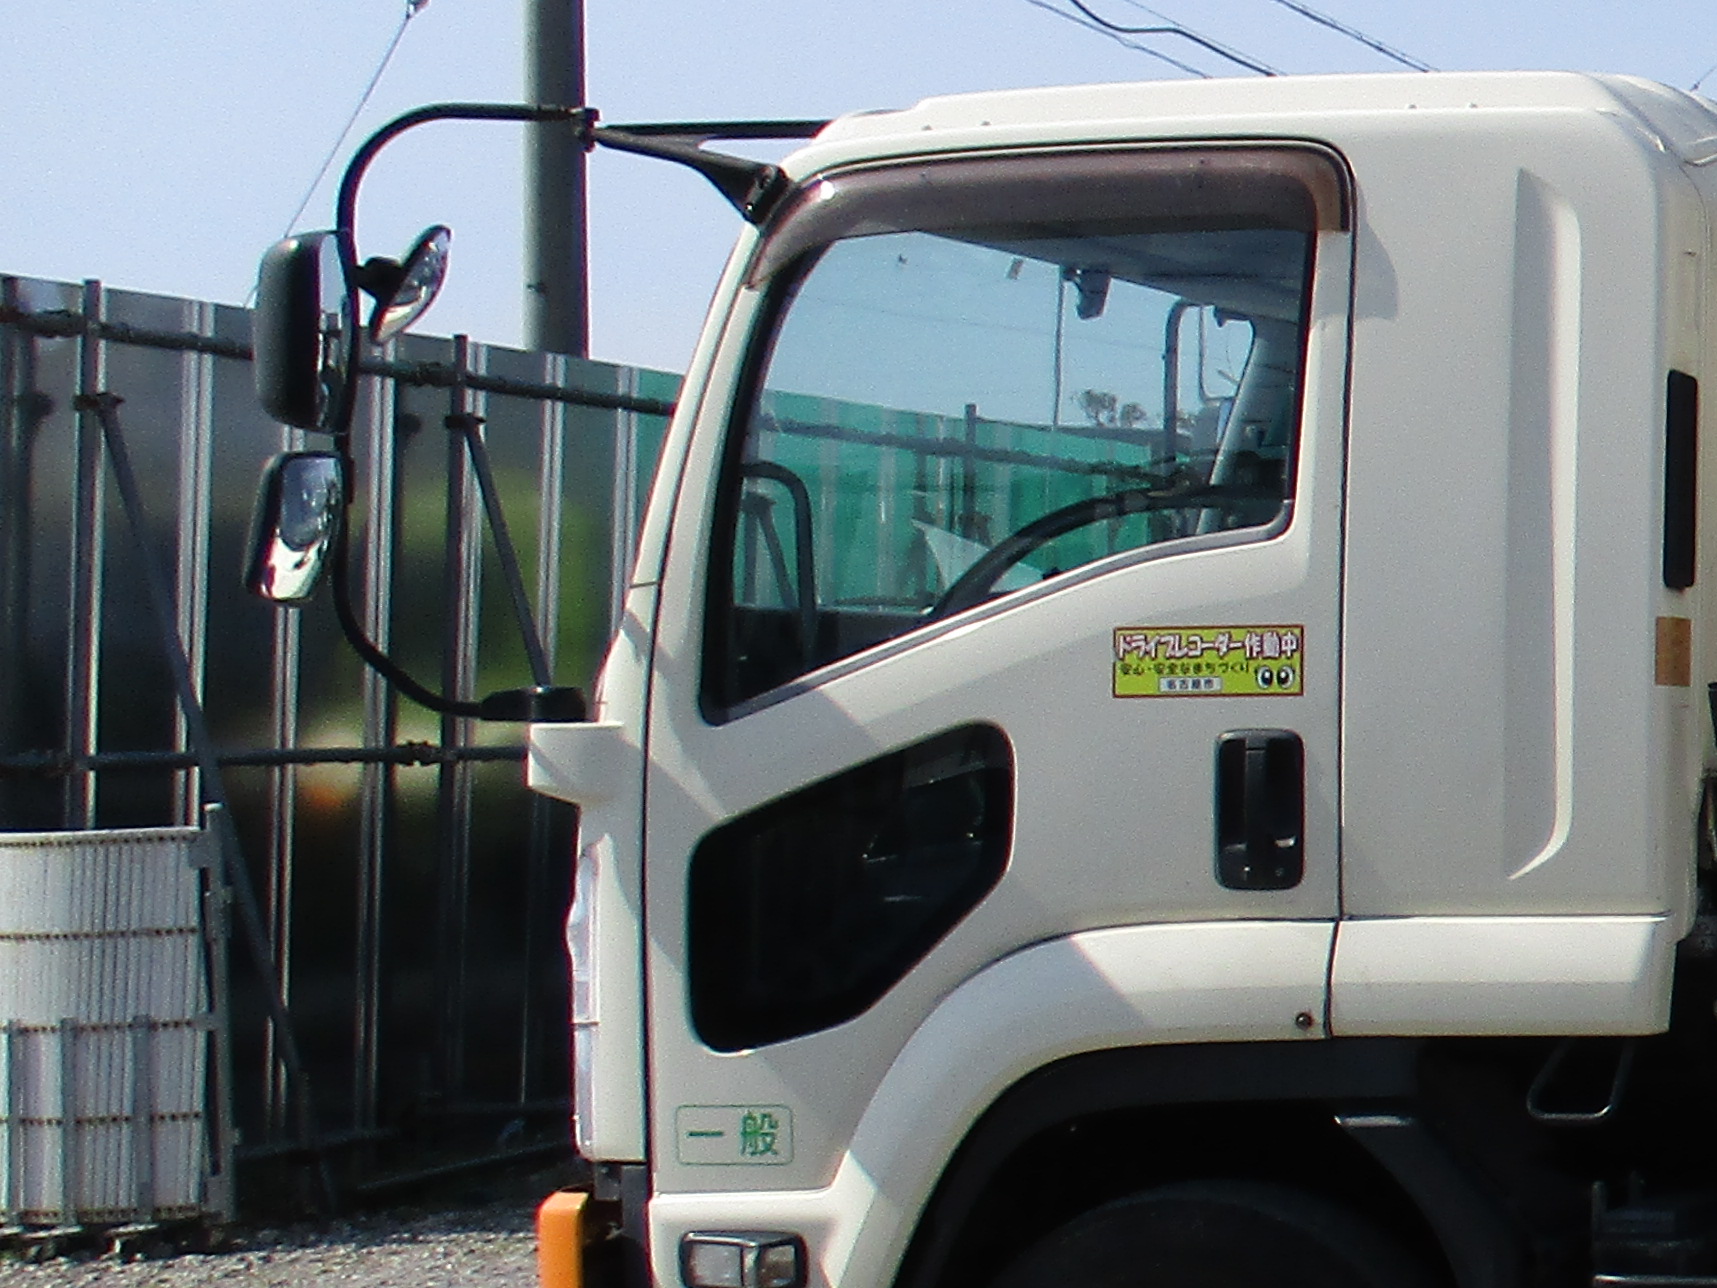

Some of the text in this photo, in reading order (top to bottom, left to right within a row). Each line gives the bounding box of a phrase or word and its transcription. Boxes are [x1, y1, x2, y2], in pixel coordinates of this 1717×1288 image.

[1118, 630, 1298, 660] ドライブレコーダー作動中
[686, 1109, 780, 1157] 一般
